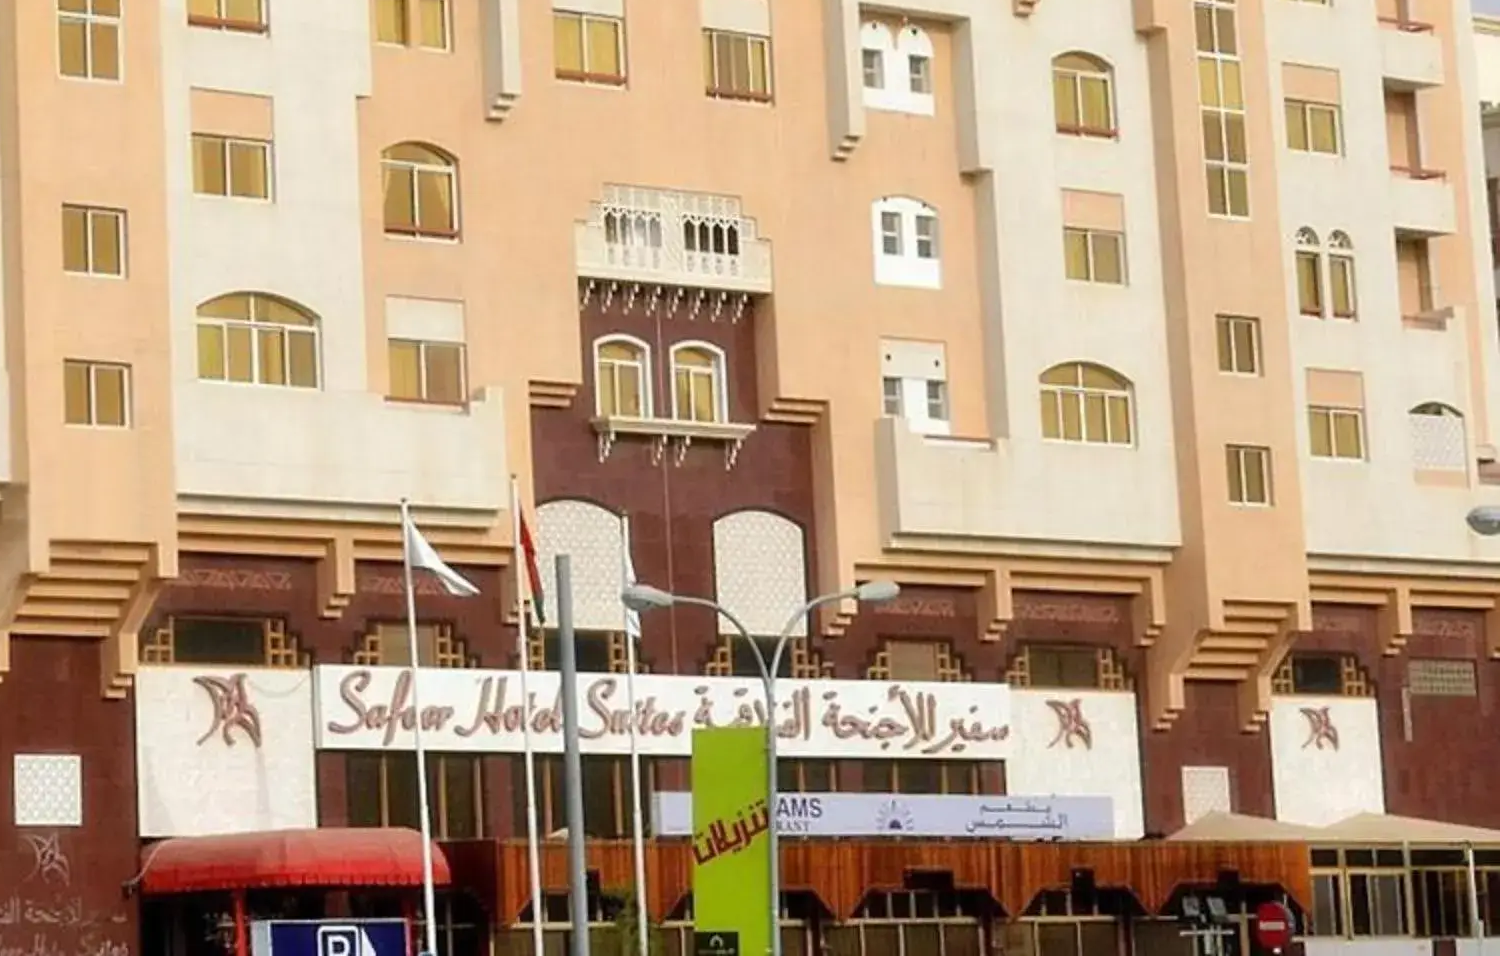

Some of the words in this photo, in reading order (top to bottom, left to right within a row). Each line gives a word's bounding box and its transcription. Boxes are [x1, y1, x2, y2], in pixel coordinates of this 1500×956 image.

[327, 669, 454, 746] Safeer
[453, 675, 564, 737] Hotel
[577, 678, 685, 739] Suites
[920, 704, 1009, 754] سفير
[776, 797, 823, 818] AMS
